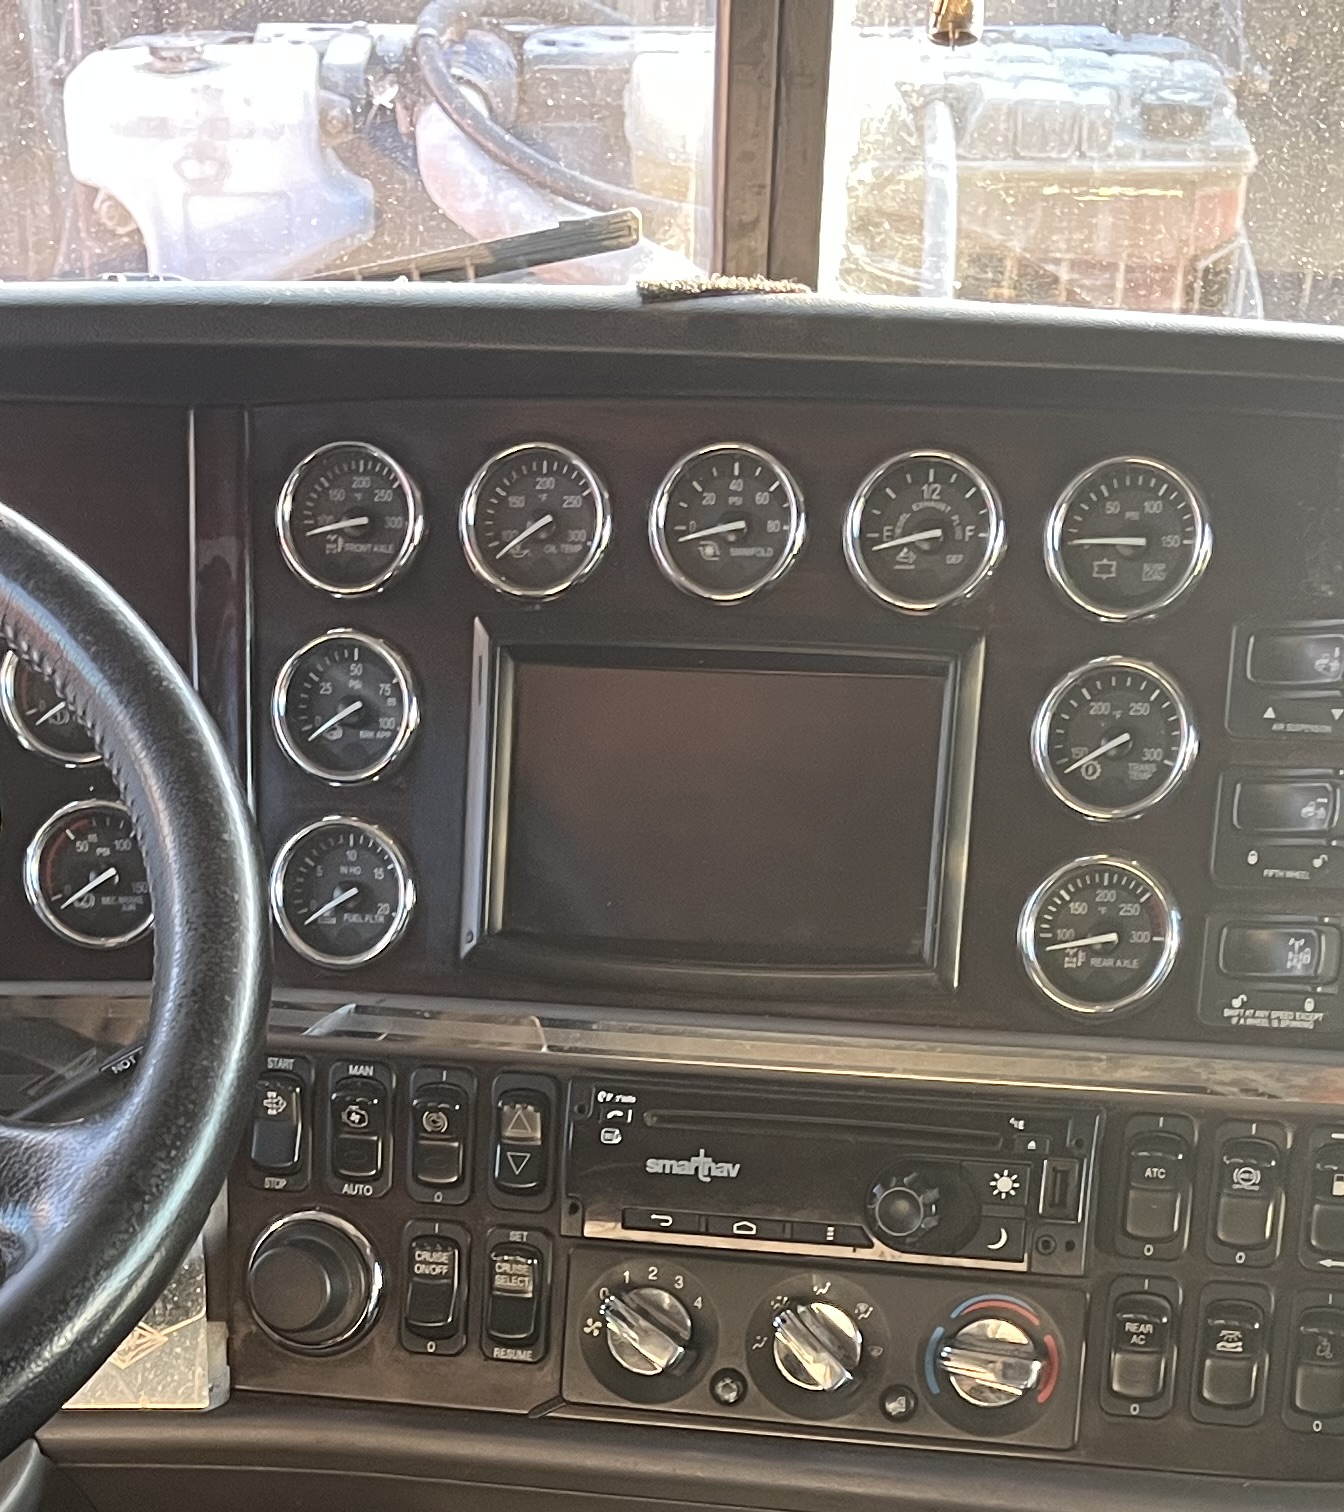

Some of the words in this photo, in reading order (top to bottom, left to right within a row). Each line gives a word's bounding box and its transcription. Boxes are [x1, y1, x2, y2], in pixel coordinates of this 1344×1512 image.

[883, 525, 894, 541] E
[965, 525, 975, 541] F
[320, 682, 332, 695] 25
[379, 683, 392, 696] 75
[1089, 702, 1110, 715] 200
[1128, 703, 1150, 716] 250
[1095, 890, 1117, 902] 200
[1069, 902, 1088, 915] 150
[1119, 903, 1141, 916] 250
[1129, 931, 1151, 943] 300
[267, 1057, 295, 1070] START
[348, 1064, 374, 1076] MAN
[645, 1148, 741, 1183] smartnav
[1144, 1167, 1166, 1179] ATC
[264, 1177, 287, 1190] STOP
[342, 1184, 373, 1197] AUTO
[509, 1230, 528, 1242] SET
[414, 1250, 449, 1264] CRUISE
[414, 1263, 449, 1276] ON/OFF
[648, 1266, 658, 1280] 2
[623, 1270, 630, 1284] 1
[674, 1275, 684, 1289] 3
[693, 1296, 703, 1309] 4
[1125, 1322, 1153, 1334] REAR
[1130, 1334, 1146, 1345] AC
[493, 1348, 533, 1361] RESUME
